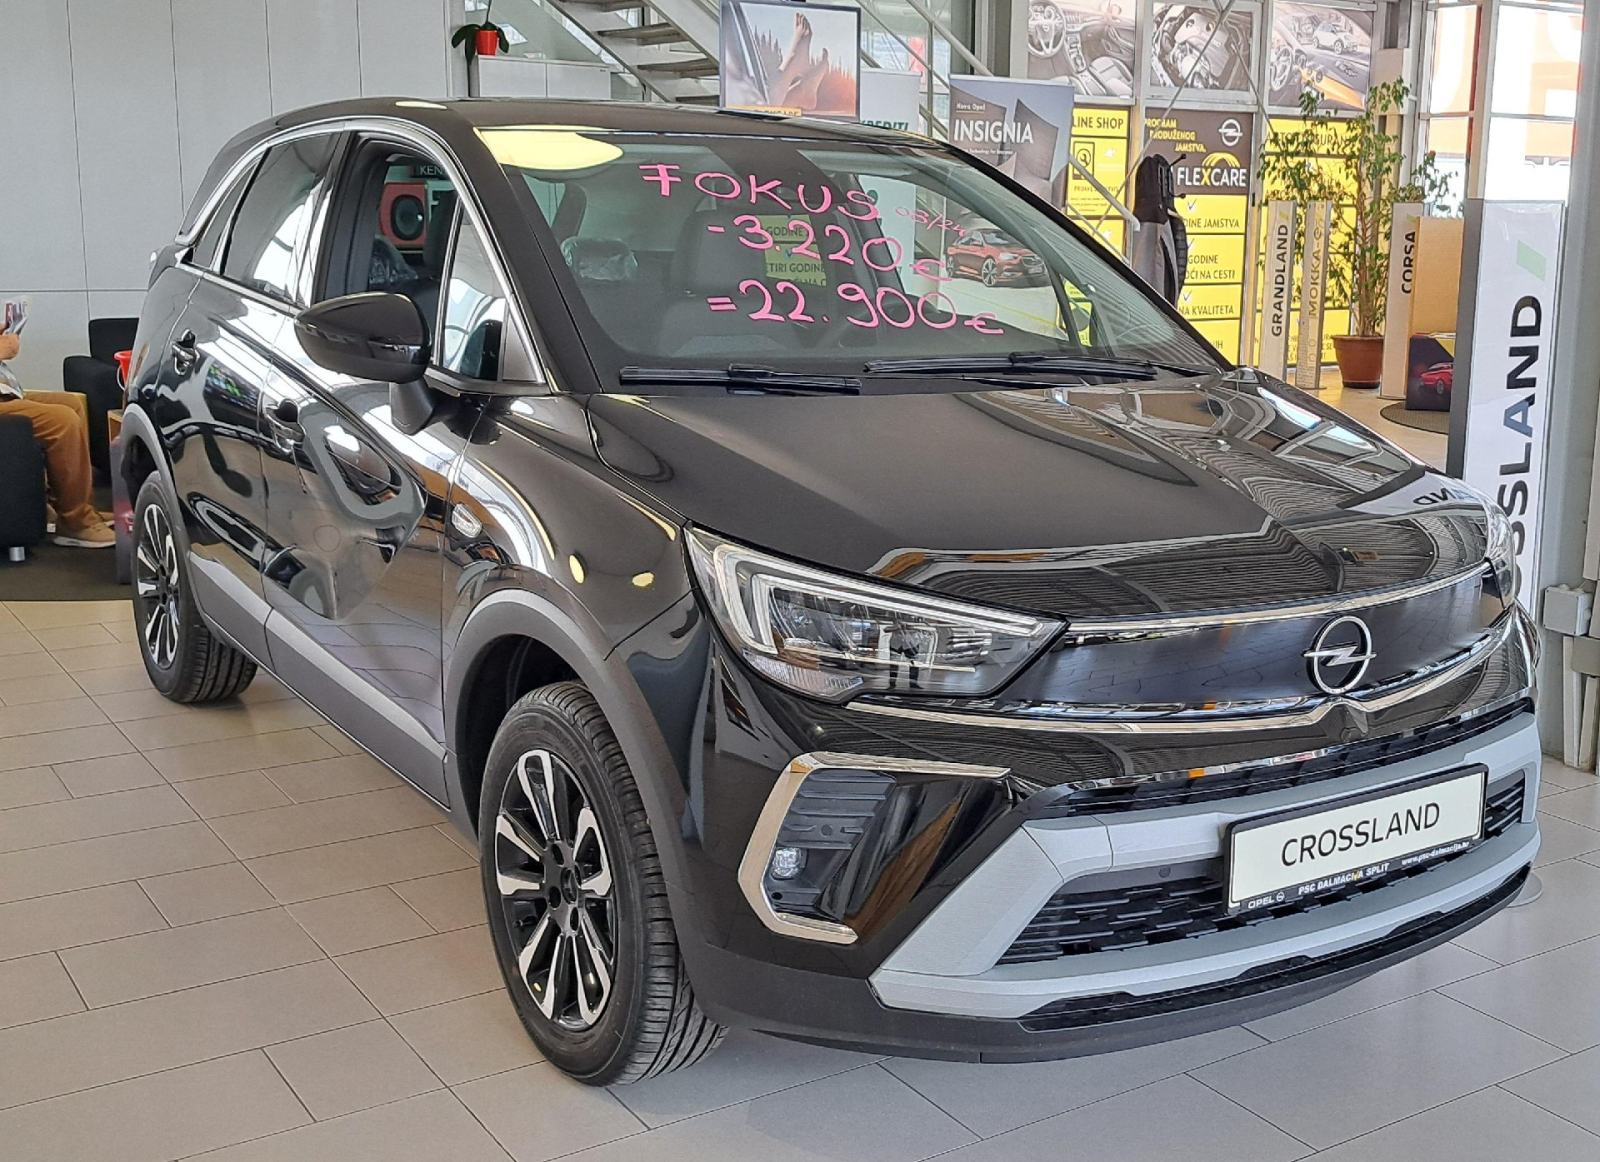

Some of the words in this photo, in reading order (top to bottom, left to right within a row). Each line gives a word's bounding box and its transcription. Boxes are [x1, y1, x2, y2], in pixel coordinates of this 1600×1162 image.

[953, 119, 1034, 144] INSIGNIA
[1096, 116, 1124, 129] SHOP
[1176, 166, 1248, 187] FLEXCARE
[639, 164, 879, 220] FOKUS
[1203, 218, 1240, 229] JAMSTVA
[1188, 255, 1219, 265] GODINE
[1401, 231, 1416, 294] CORSA
[1199, 270, 1211, 279] NA
[1213, 269, 1235, 279] CESTI
[1271, 224, 1289, 337] GRANDLAND
[1191, 304, 1235, 316] KVALITETA
[1281, 802, 1440, 867] CROSSLAND
[1248, 895, 1275, 909] OPEL
[1298, 883, 1316, 896] PSC
[1366, 862, 1390, 877] SPLIT
